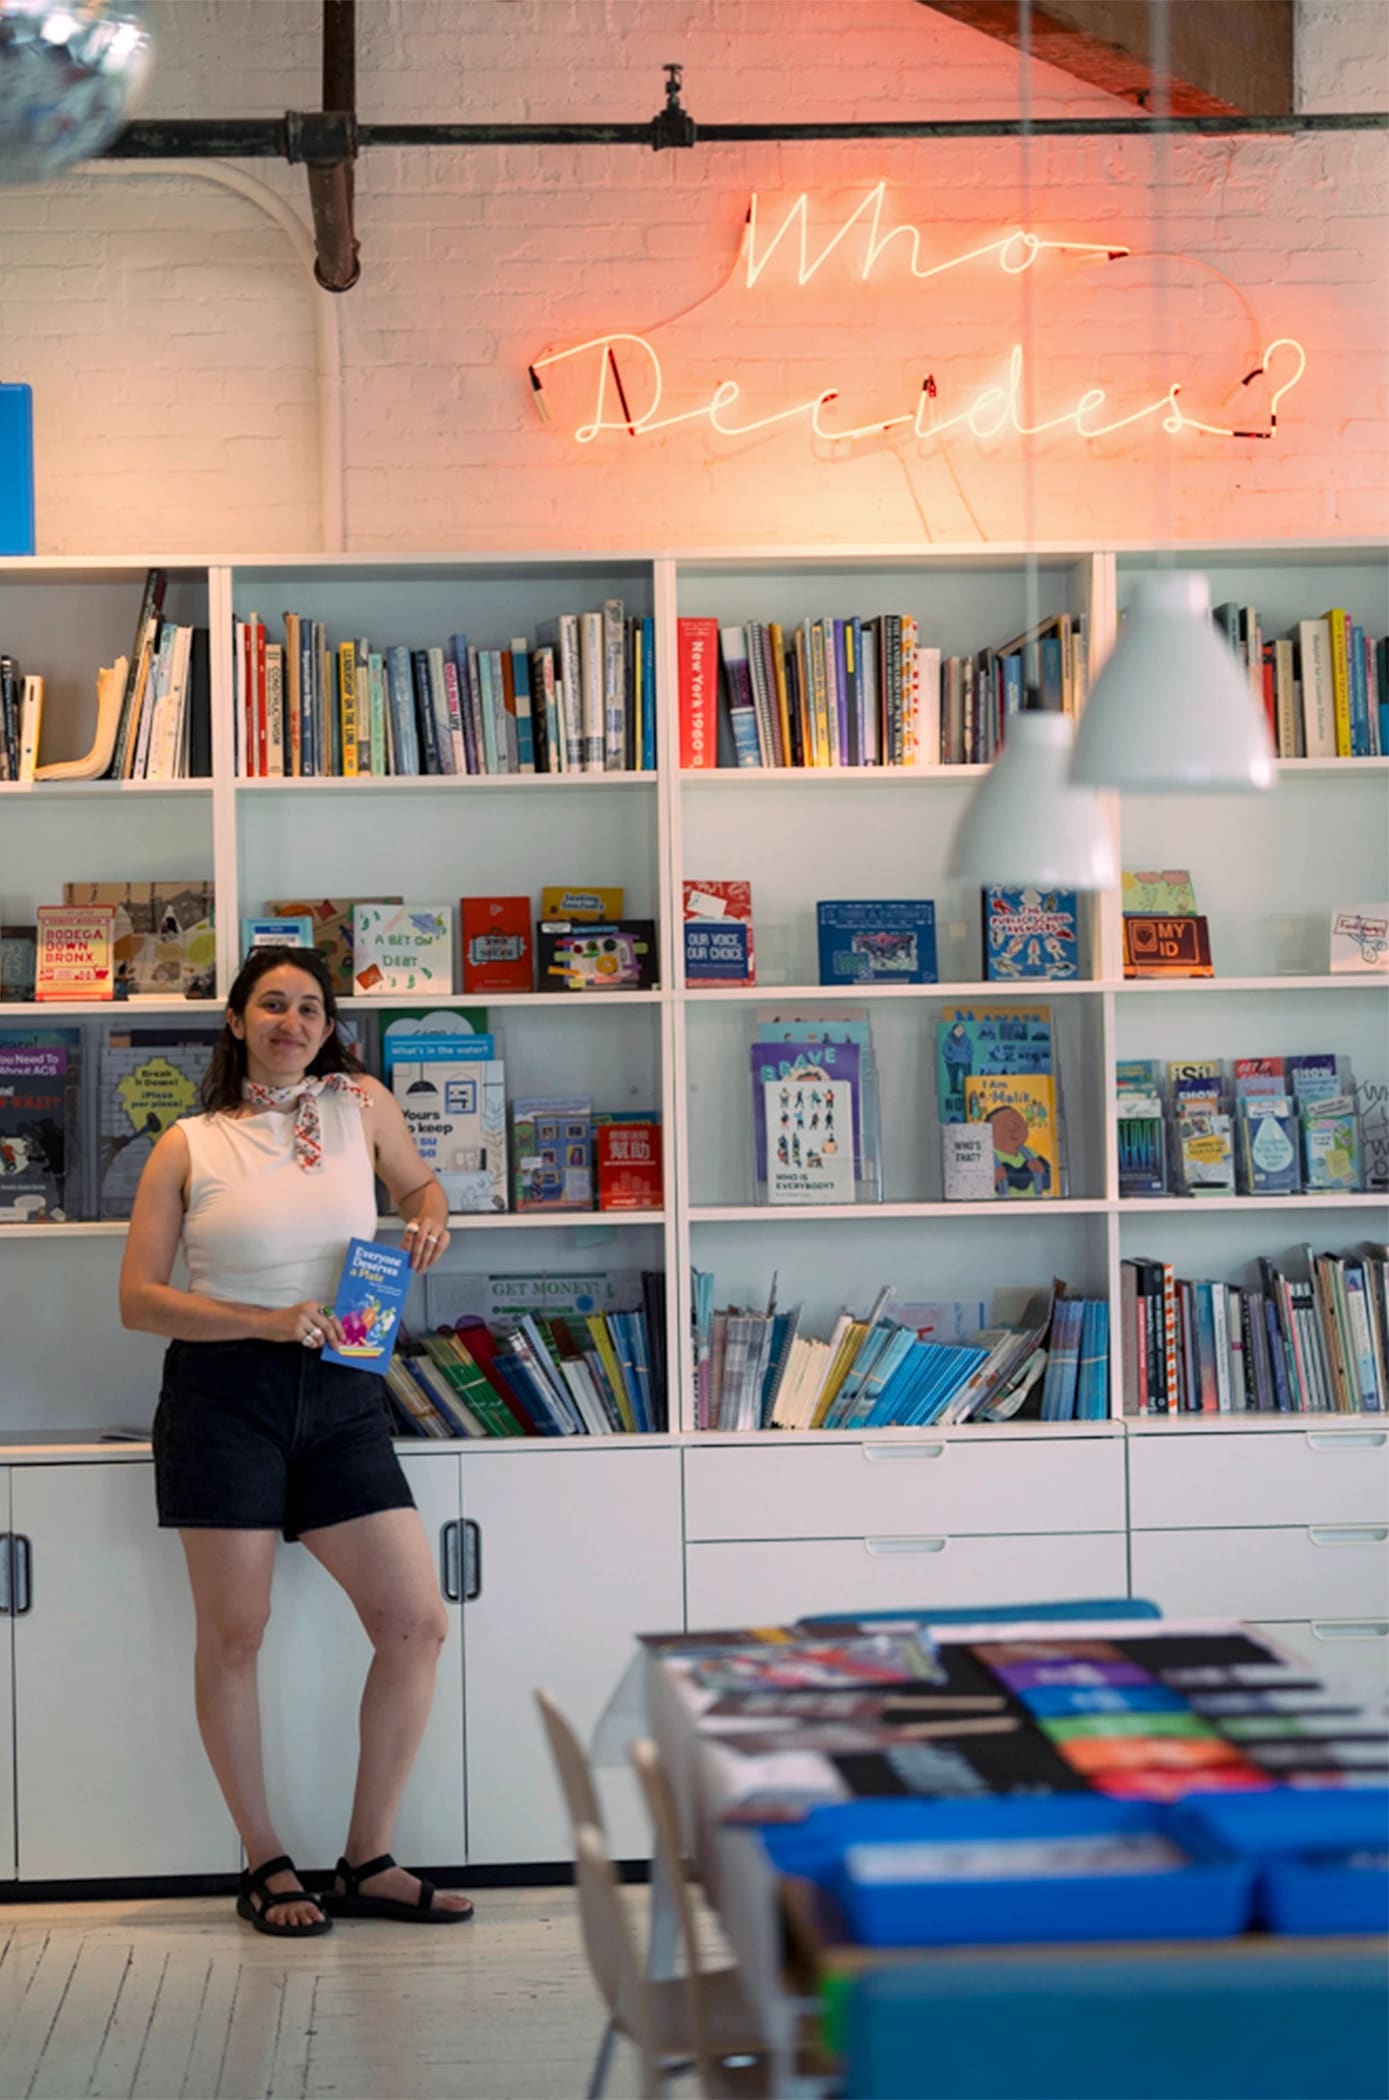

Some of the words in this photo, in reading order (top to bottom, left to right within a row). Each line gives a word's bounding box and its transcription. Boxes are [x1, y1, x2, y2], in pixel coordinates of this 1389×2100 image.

[746, 181, 1128, 288] Who
[530, 333, 1306, 442] Decides?
[691, 641, 704, 672] New
[344, 648, 354, 695] LEADERSHIP
[691, 674, 704, 709] York
[345, 698, 354, 709] ON
[345, 712, 354, 725] THE
[345, 728, 354, 745] LINE
[691, 712, 704, 751] 1960
[1021, 905, 1041, 914] THE
[46, 929, 103, 940] BODEGA
[1158, 924, 1185, 938] MY
[375, 935, 384, 945] A
[387, 935, 411, 945] BET
[414, 935, 433, 945] ON
[687, 933, 709, 945] OUR
[46, 941, 89, 951] DOWN
[1160, 941, 1179, 957] ID
[45, 953, 95, 963] BRONX
[687, 946, 708, 960] OUR
[382, 955, 418, 967] DEBT
[391, 1046, 425, 1055] What's
[426, 1046, 435, 1055] in
[437, 1046, 454, 1055] the
[457, 1045, 488, 1055] water?
[15, 1053, 44, 1065] Need
[46, 1053, 59, 1063] To
[761, 1047, 836, 1082] BRAVE
[33, 1066, 57, 1076] ACS
[144, 1079, 178, 1087] Down!
[989, 1079, 1008, 1088] Am
[992, 1092, 1031, 1105] Malik
[402, 1109, 440, 1121] Yours
[418, 1122, 453, 1136] keep
[420, 1137, 438, 1146] su
[954, 1142, 982, 1150] WHO'S
[955, 1153, 981, 1162] THAT?
[776, 1182, 835, 1190] EVERYBODY?
[355, 1246, 402, 1267] Everyone
[353, 1257, 398, 1277] Deserves
[358, 1268, 384, 1282] Plate
[491, 1282, 531, 1297] GET
[532, 1280, 600, 1297] MONEY!
